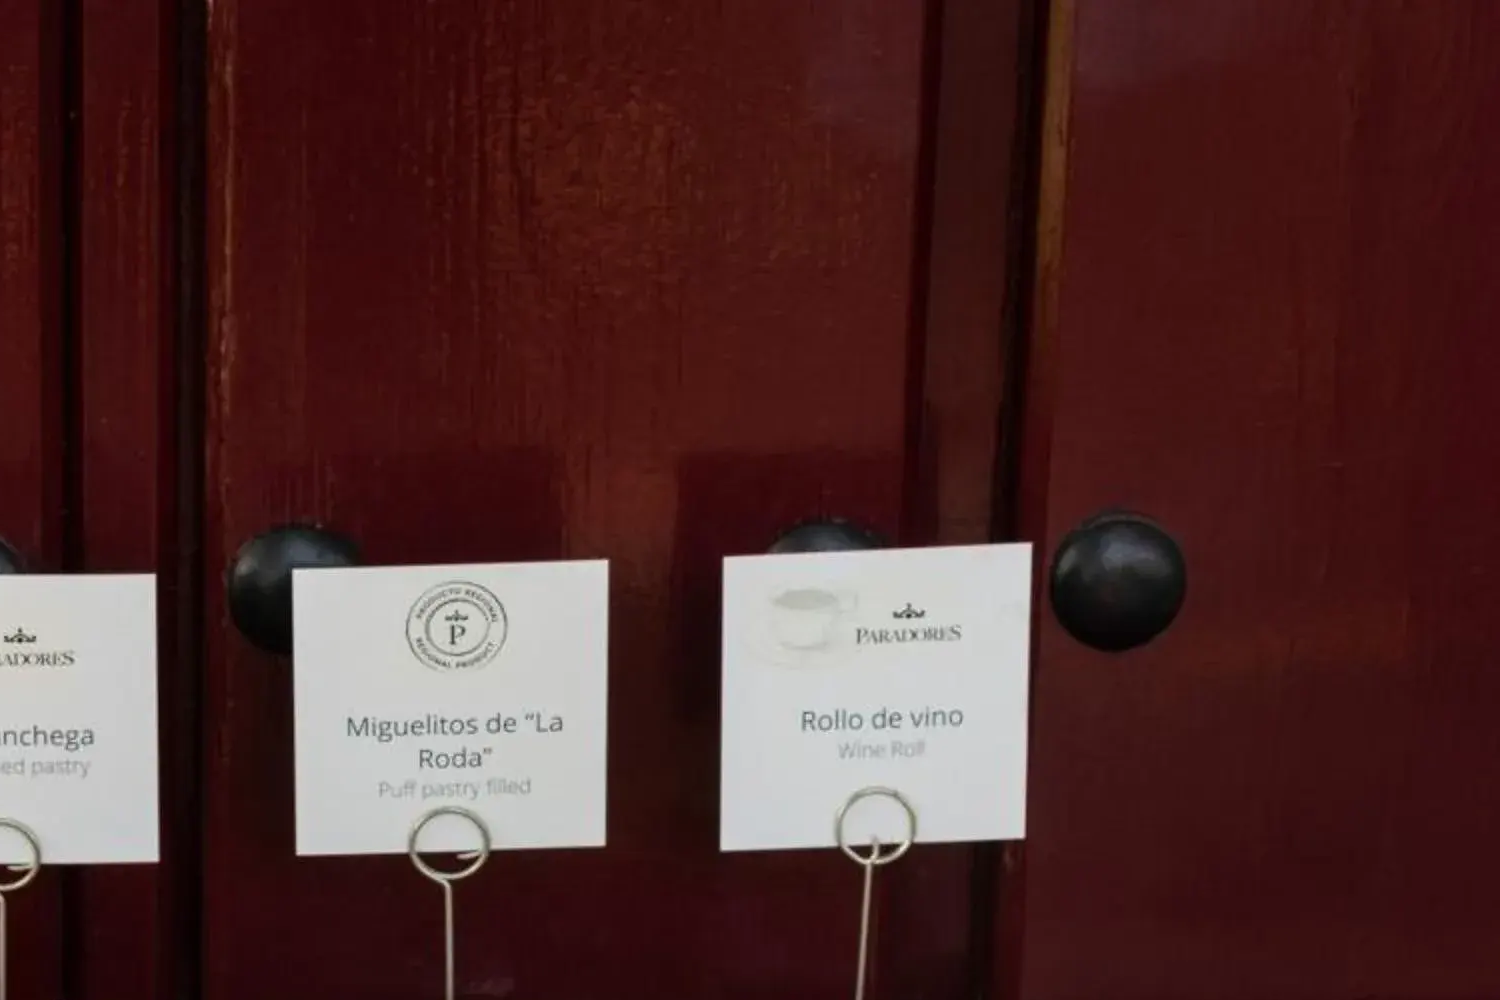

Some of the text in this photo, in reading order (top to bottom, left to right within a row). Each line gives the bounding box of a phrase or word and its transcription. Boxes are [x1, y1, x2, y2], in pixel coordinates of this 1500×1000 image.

[449, 624, 466, 645] P
[855, 625, 962, 645] PARADORES
[346, 714, 479, 743] Miguelitos
[485, 713, 517, 734] de
[801, 706, 964, 732] Rollo de vino
[838, 739, 926, 760] Wine Roll
[31, 757, 91, 779] pastry
[378, 778, 532, 801] Puff pastry filled
